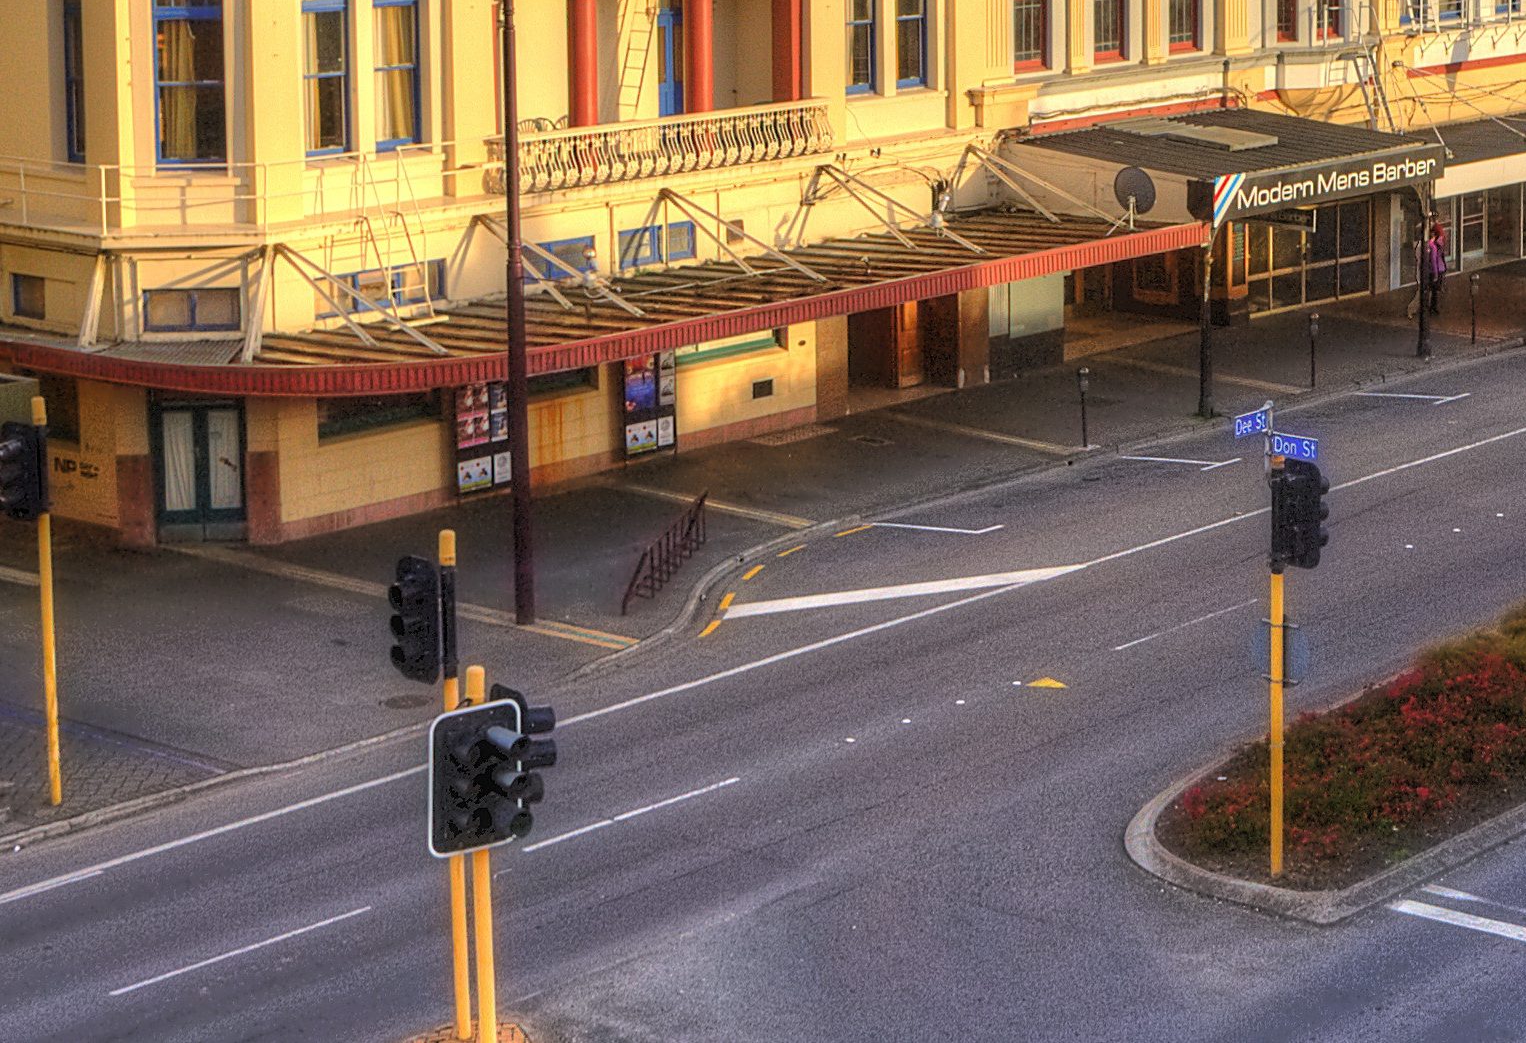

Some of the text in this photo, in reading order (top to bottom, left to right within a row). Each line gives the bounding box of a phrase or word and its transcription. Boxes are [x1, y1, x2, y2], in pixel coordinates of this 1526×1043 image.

[1236, 157, 1436, 210] Modern Mens Barber
[1235, 413, 1266, 435] Dee St
[1274, 436, 1315, 458] Don St
